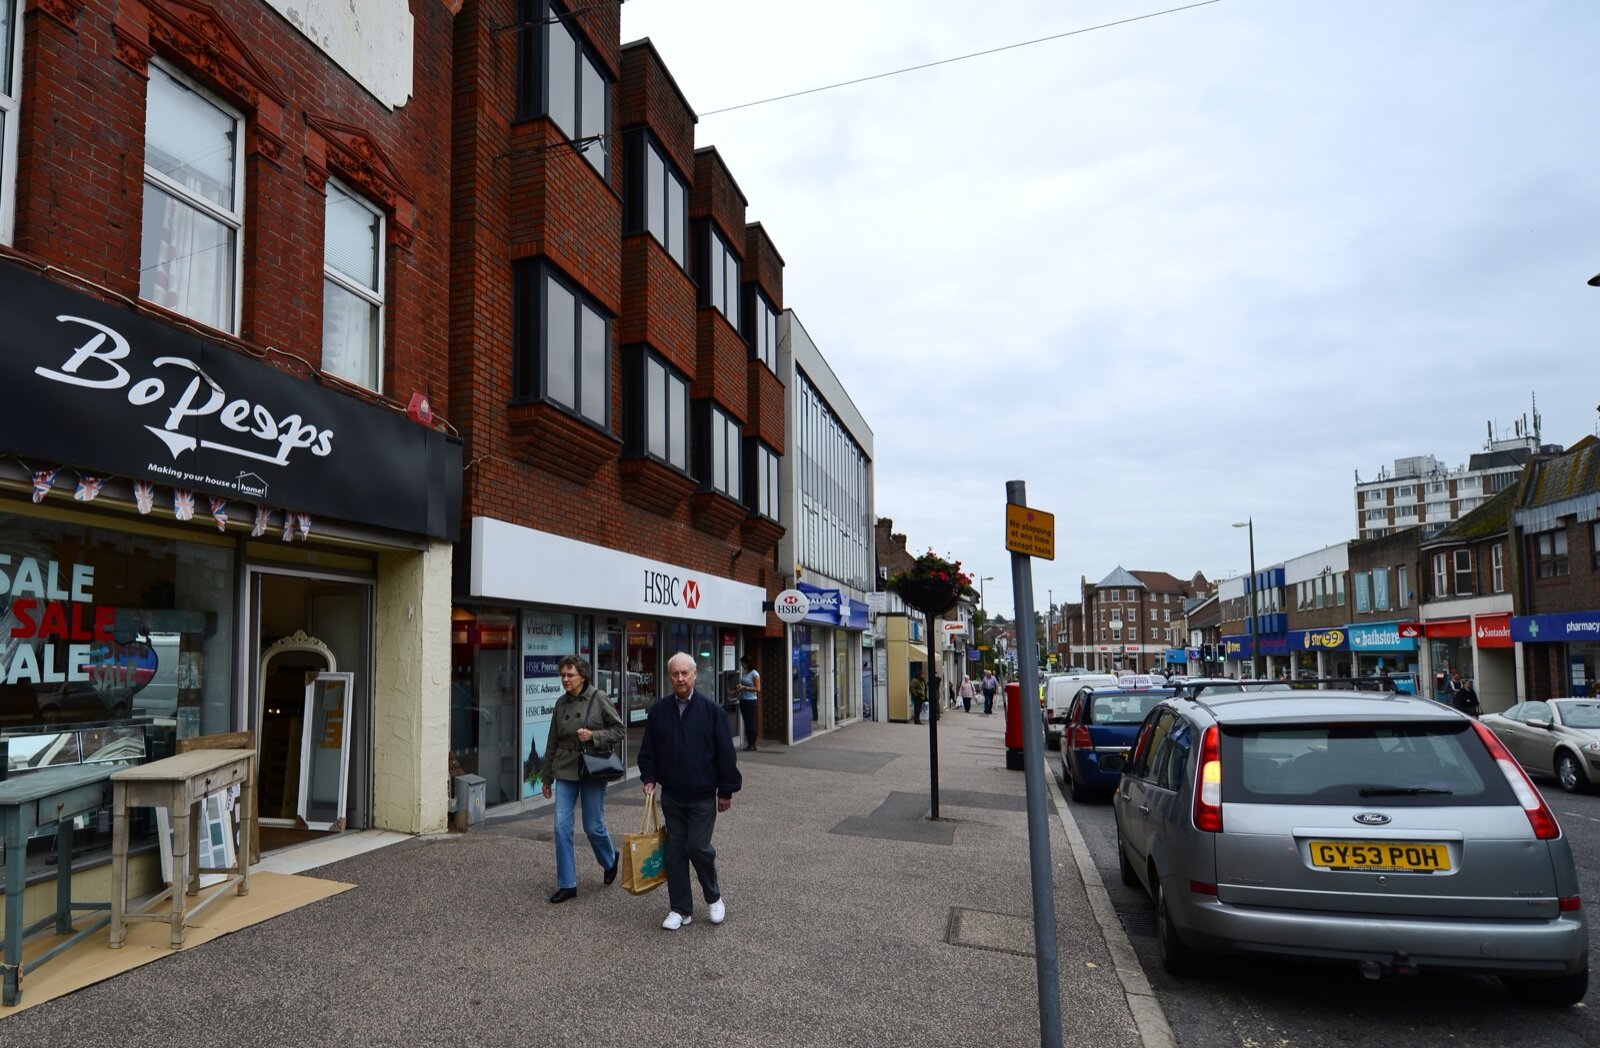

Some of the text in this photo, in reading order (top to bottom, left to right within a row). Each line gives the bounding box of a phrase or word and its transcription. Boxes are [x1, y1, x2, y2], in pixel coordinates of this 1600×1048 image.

[147, 463, 183, 478] Making
[183, 472, 204, 482] your
[205, 476, 230, 487] house
[241, 484, 265, 494] home!
[1010, 520, 1051, 537] No stopping
[1021, 532, 1033, 541] any
[1035, 534, 1050, 544] time
[1010, 540, 1052, 555] except taxis
[644, 570, 680, 606] HSBC
[777, 604, 805, 614] HSBC
[11, 598, 116, 641] SALE
[526, 617, 563, 636] Welcome
[1566, 620, 1600, 633] pharmacy
[1362, 629, 1400, 646] bathstore
[1485, 626, 1511, 637] Santander
[0, 643, 91, 685] ALE
[541, 661, 559, 673] Premie
[525, 683, 560, 695] HSBC Advance
[525, 705, 541, 718] HSBC
[1363, 813, 1382, 822] Ford
[1320, 845, 1439, 867] GY53 POH
